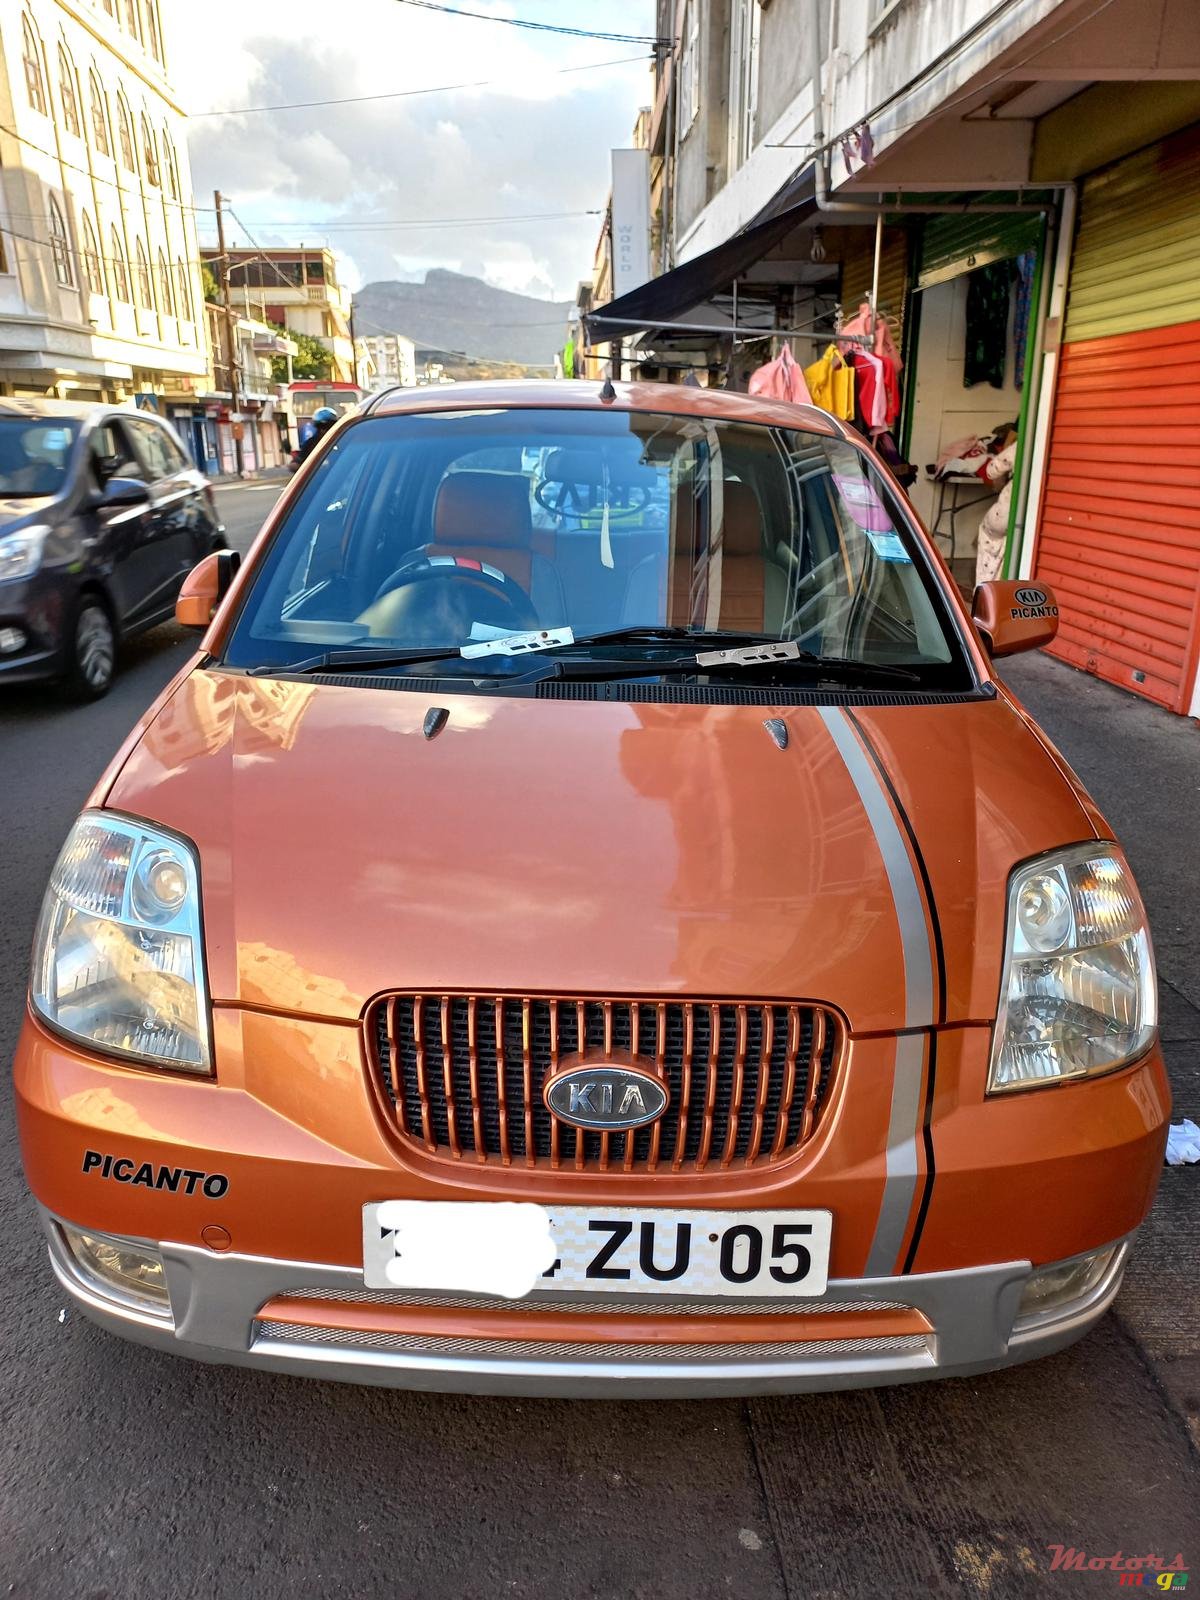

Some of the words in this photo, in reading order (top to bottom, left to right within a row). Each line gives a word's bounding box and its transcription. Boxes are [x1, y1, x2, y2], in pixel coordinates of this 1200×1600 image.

[1020, 591, 1043, 602] KIA
[1011, 606, 1059, 619] PICANTO
[569, 1083, 647, 1114] KIA
[82, 1150, 230, 1199] PICANTO
[586, 1220, 691, 1281] ZU
[719, 1224, 813, 1284] 05
